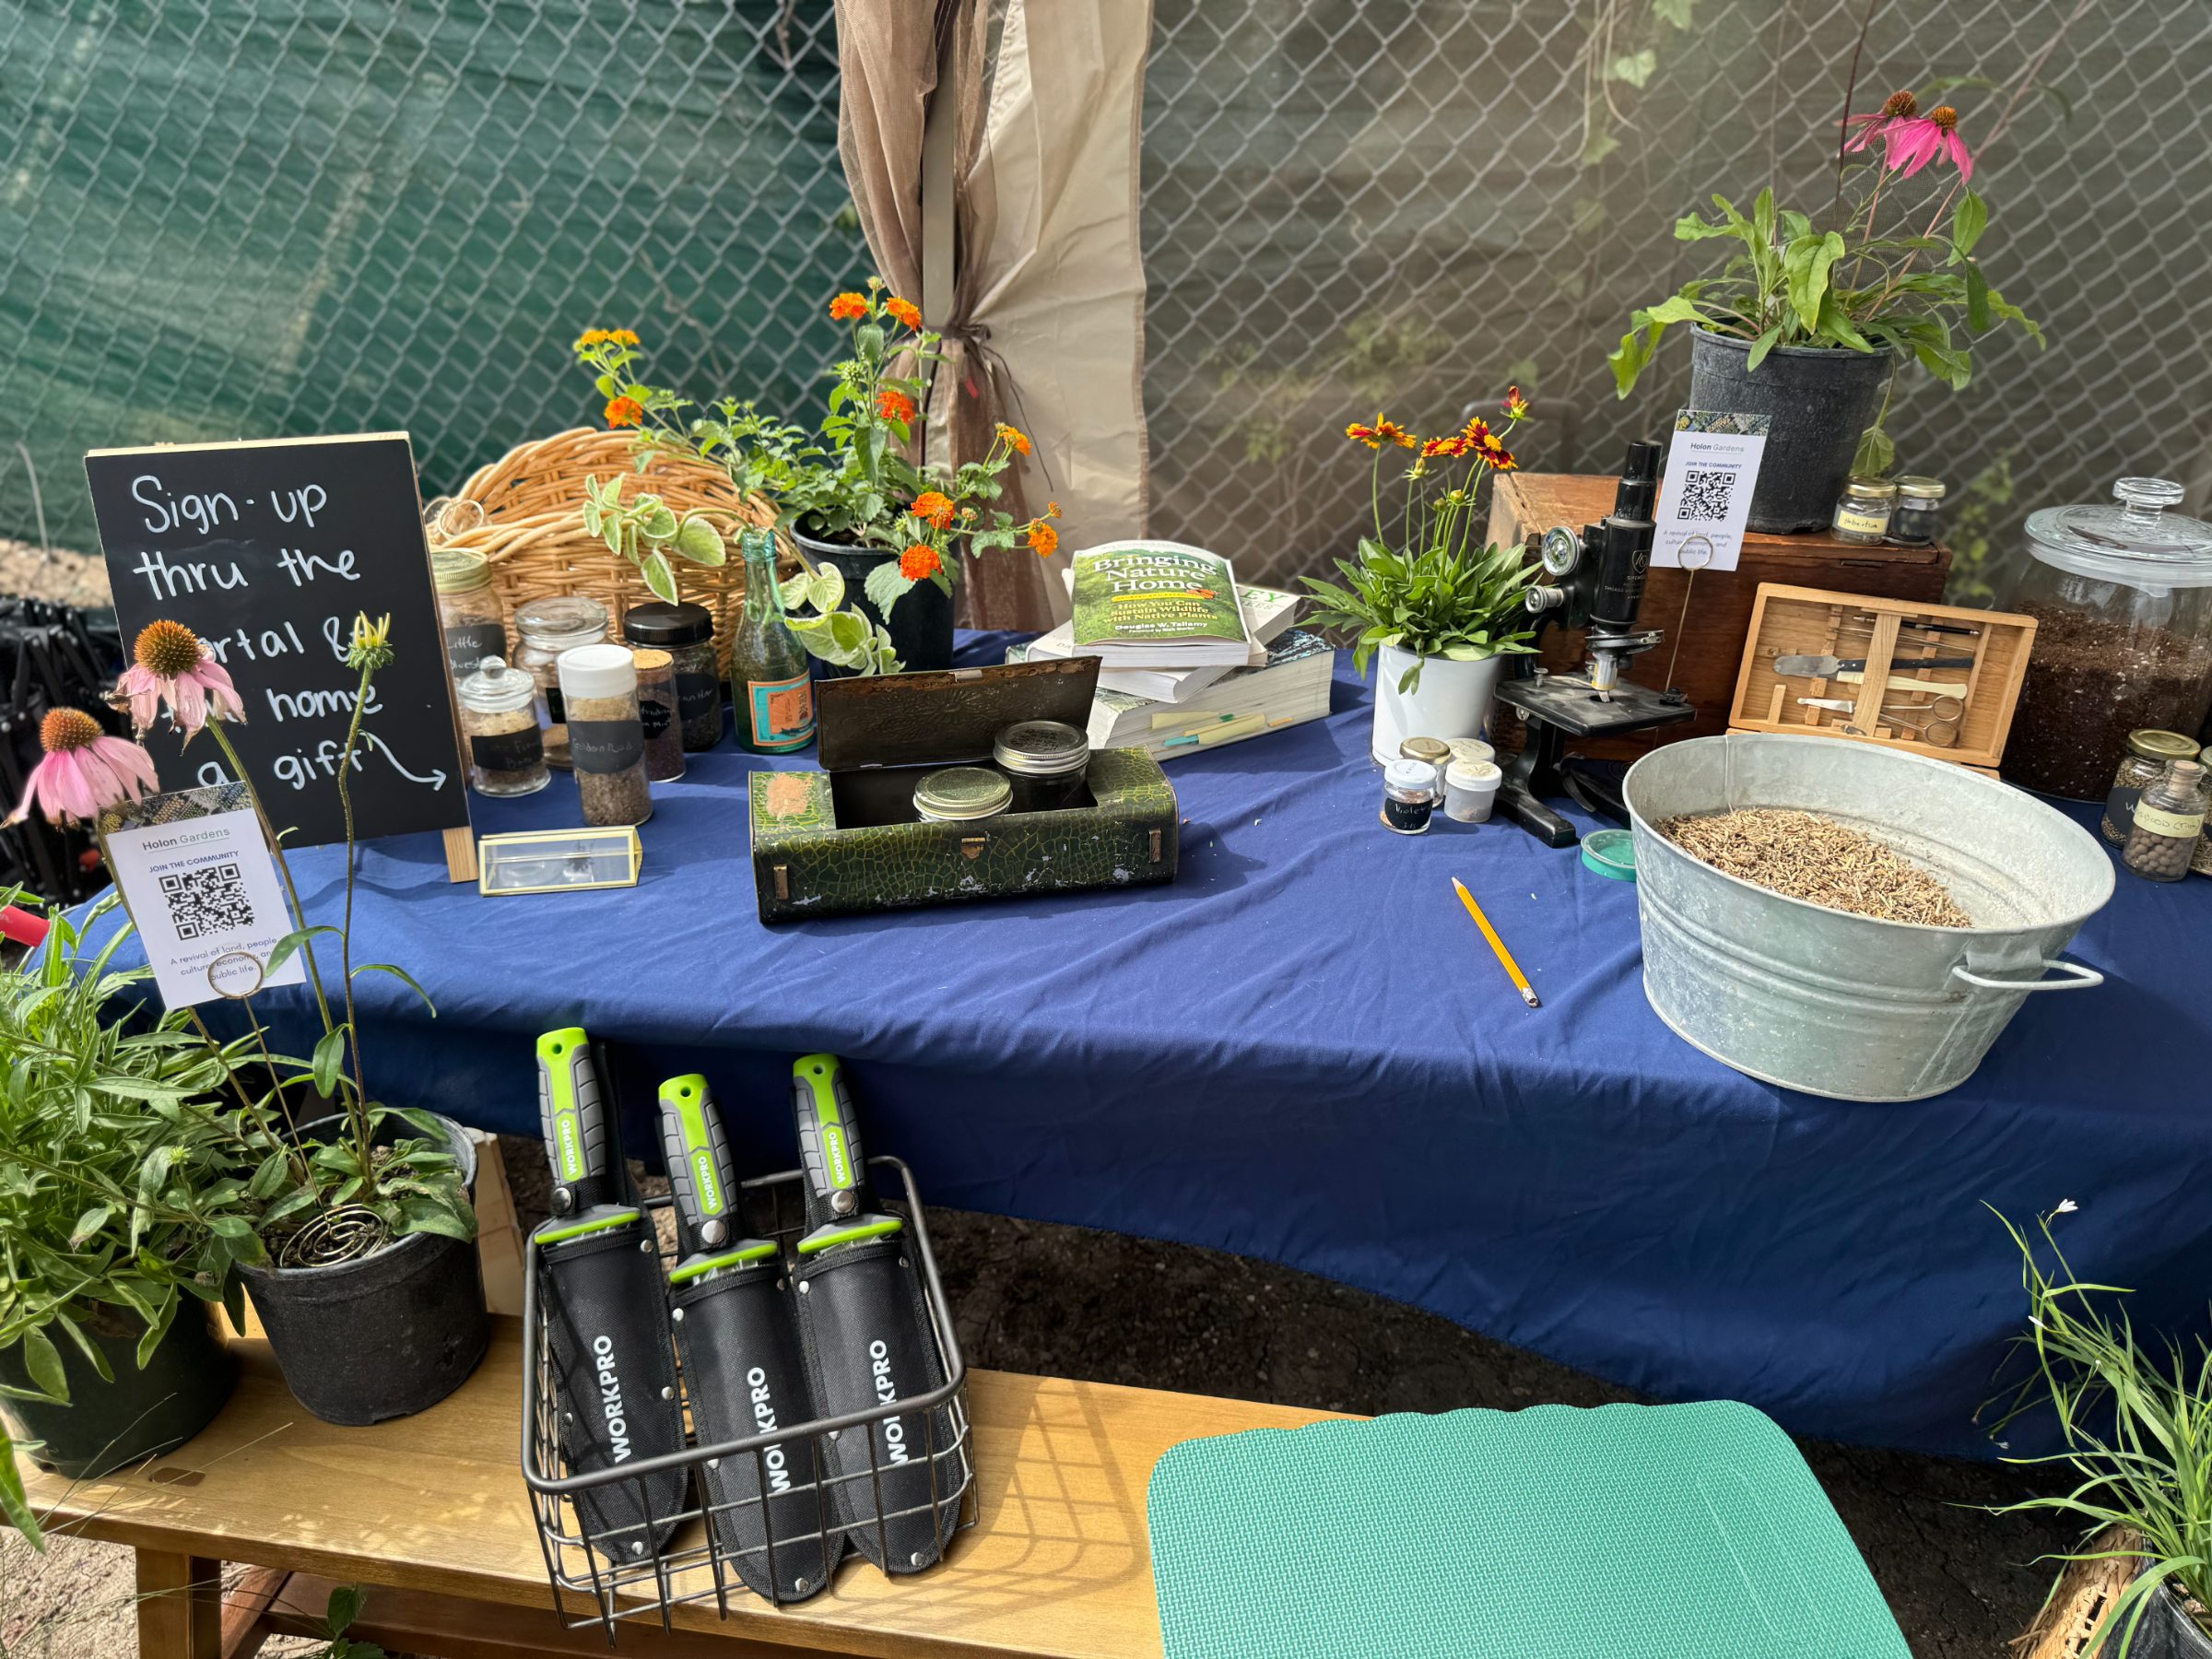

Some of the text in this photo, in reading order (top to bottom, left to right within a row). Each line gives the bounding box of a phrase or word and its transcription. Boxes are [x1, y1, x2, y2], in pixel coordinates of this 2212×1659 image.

[1690, 442, 1745, 452] Holon Gardens
[133, 547, 361, 601] thru the
[1093, 556, 1217, 576] Bringing
[1107, 566, 1206, 582] Nature
[1112, 579, 1203, 593] Home
[1103, 611, 1218, 624] with Native Plants
[1111, 606, 1209, 618] Sustain Wildlife
[266, 685, 383, 723] home
[197, 739, 365, 791] a gift
[142, 829, 230, 851] Holon Gardens
[149, 850, 240, 873] JOIN THE COMMUNITY
[179, 950, 208, 963] revival
[210, 947, 221, 956] of
[222, 943, 246, 954] land,
[239, 965, 256, 974] life.
[561, 1119, 577, 1174] WORKPRO
[829, 1131, 845, 1182] WORKPRO
[698, 1155, 718, 1210] WORKPRO
[593, 1335, 631, 1464] WORKPRO
[747, 1367, 791, 1493] WOKPRO
